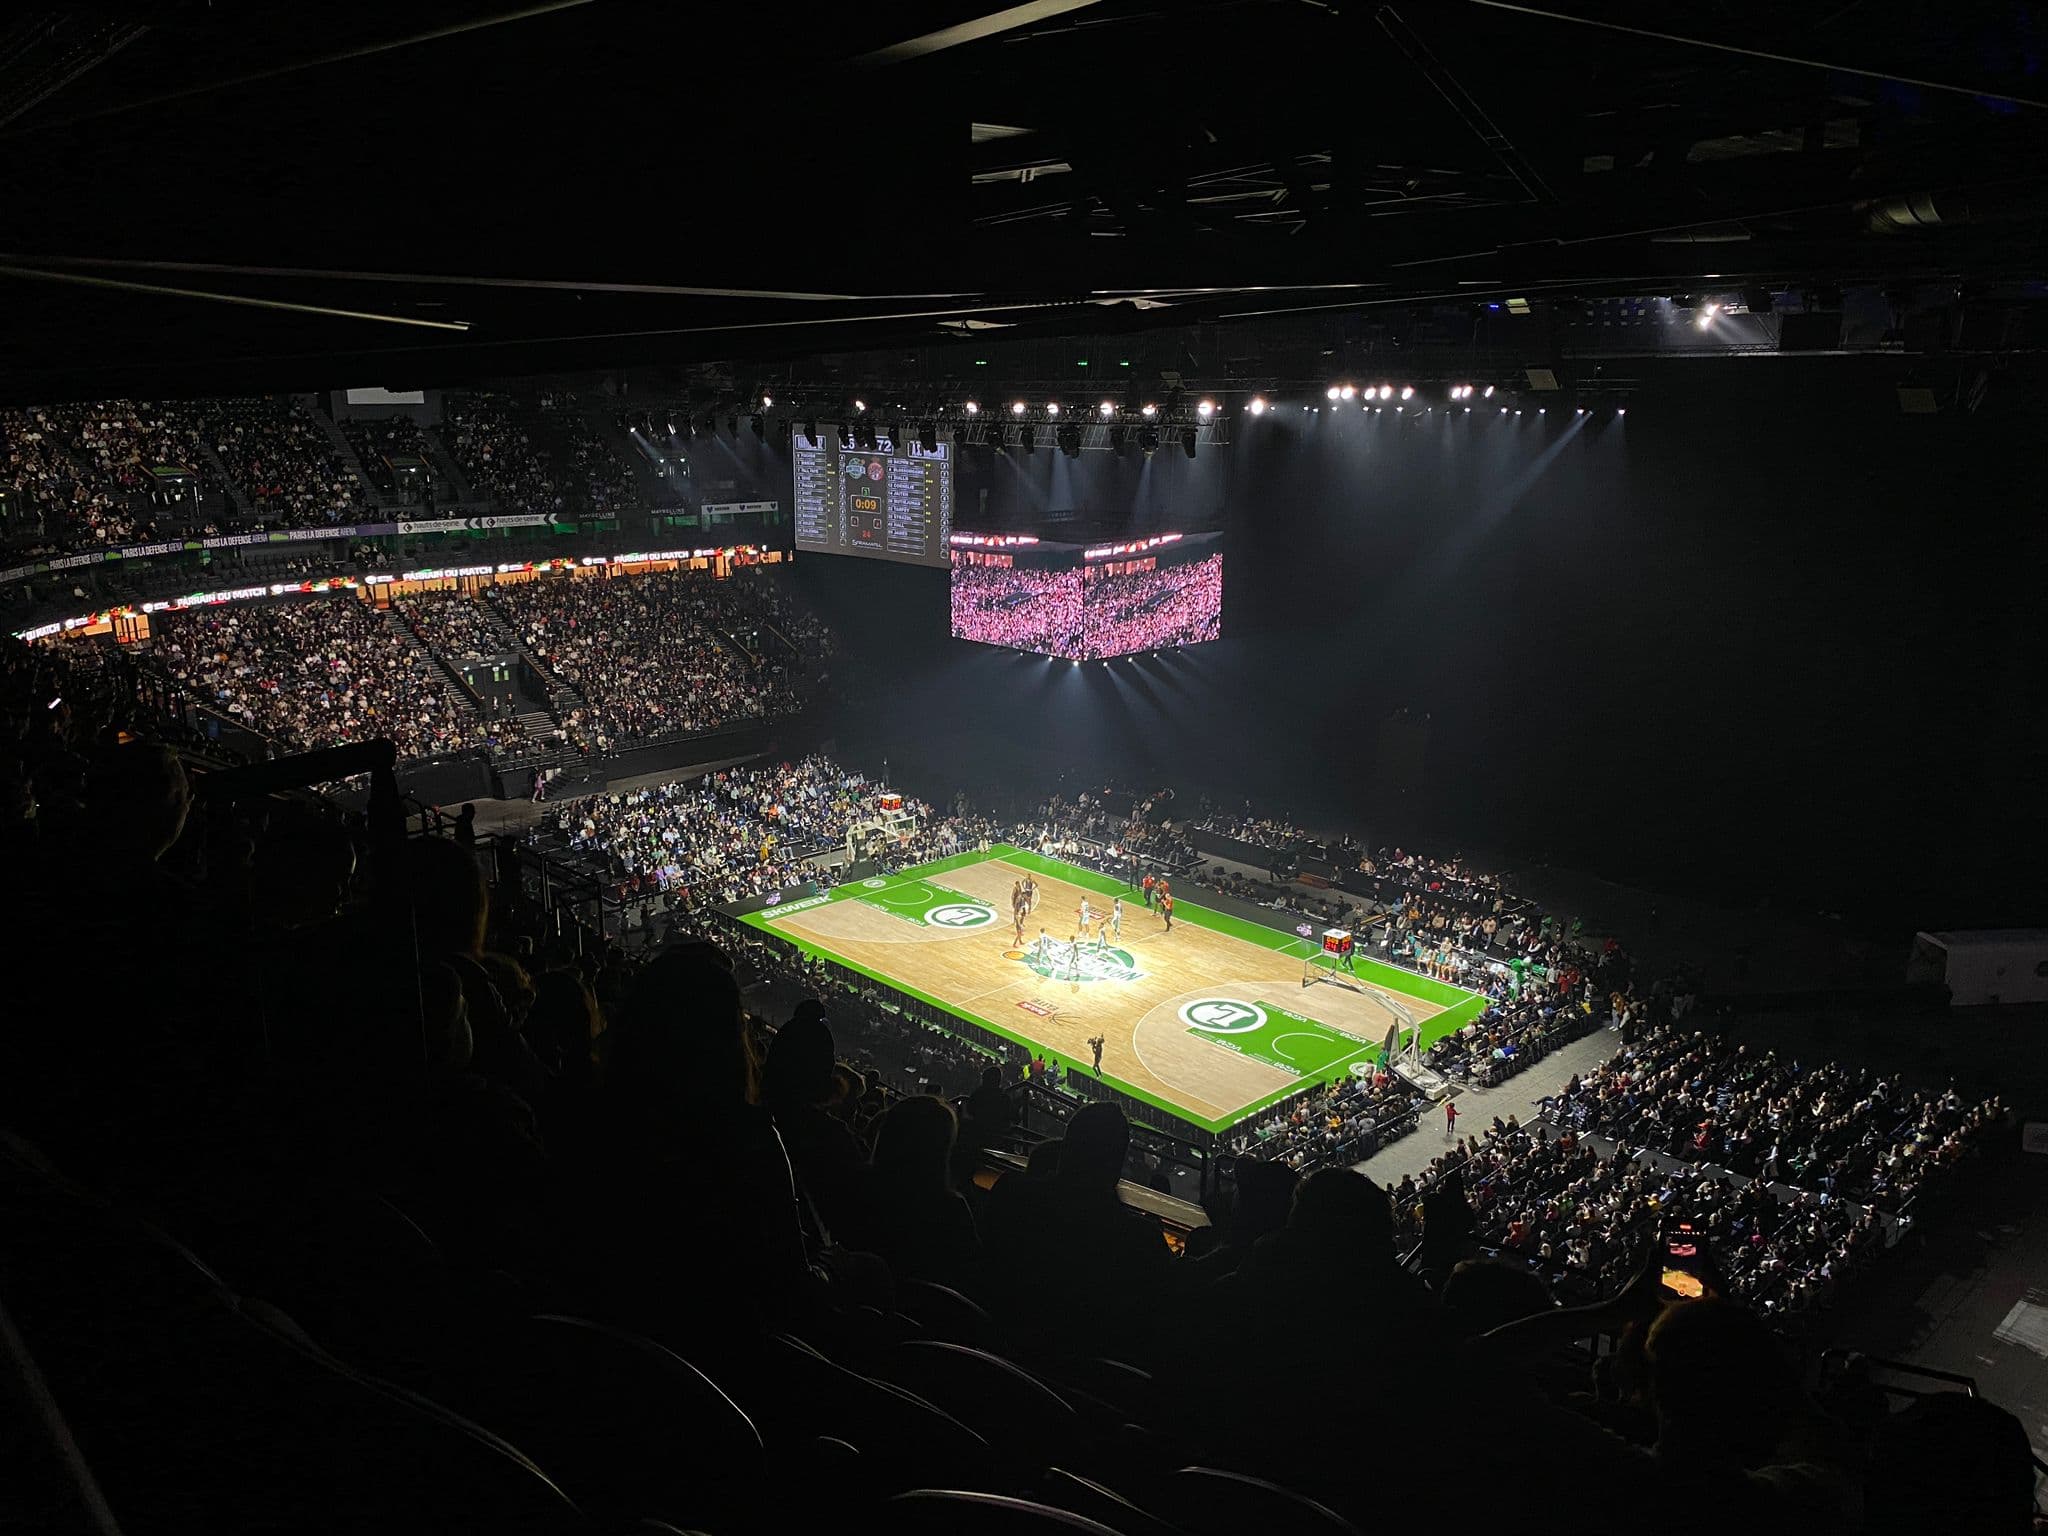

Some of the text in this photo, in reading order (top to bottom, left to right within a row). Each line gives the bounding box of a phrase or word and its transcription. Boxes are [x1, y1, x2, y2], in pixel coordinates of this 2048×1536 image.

[877, 439, 892, 452] 72
[855, 499, 877, 510] 0:09
[289, 527, 357, 540] PARIS LA DEFENSE ARENA
[203, 534, 268, 548] PARIS LA DEFENSE ARENA
[122, 547, 138, 558] PARIS
[138, 547, 146, 556] LA
[146, 543, 168, 556] DEFENSE
[661, 551, 689, 560] MATCH
[50, 558, 64, 570] PARIS
[64, 558, 71, 568] LA
[70, 554, 91, 567] DEFENSE
[445, 569, 458, 577] DU
[459, 567, 492, 577] MATCH
[218, 590, 231, 600] DU
[232, 587, 266, 599] MATCH
[761, 895, 833, 918] SKWEEK
